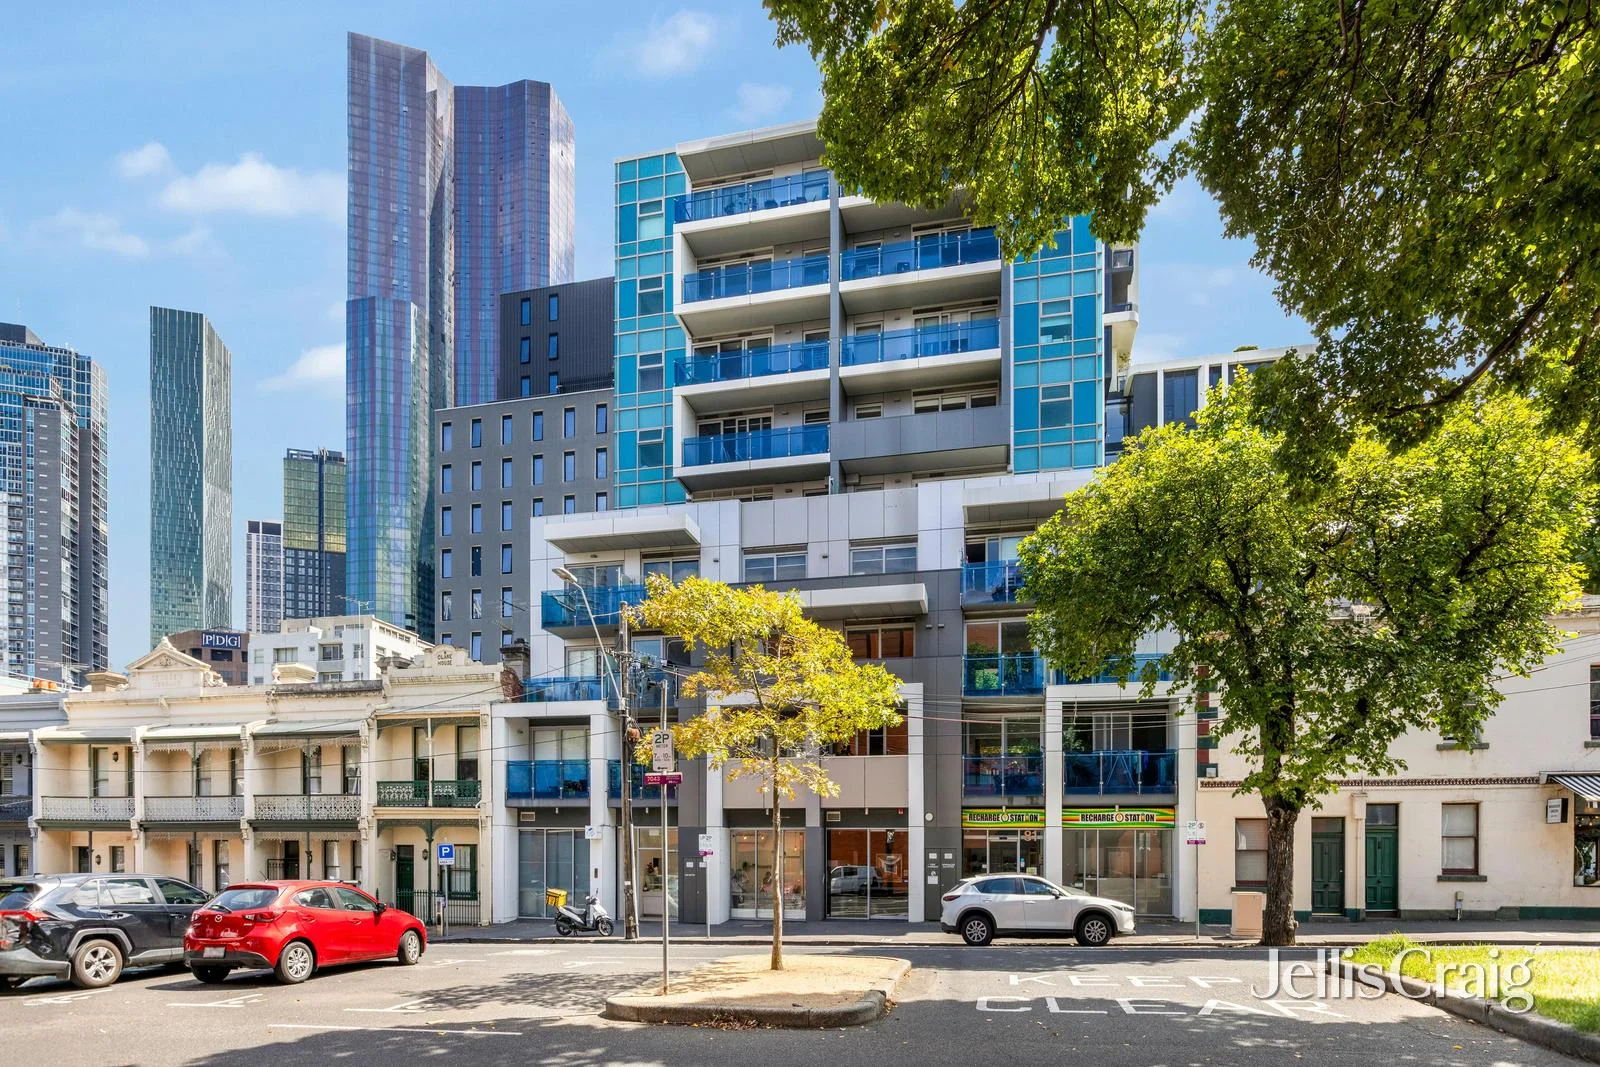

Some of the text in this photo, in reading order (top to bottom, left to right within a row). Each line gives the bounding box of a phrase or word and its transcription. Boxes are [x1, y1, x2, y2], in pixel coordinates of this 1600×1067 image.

[655, 734, 669, 743] 2P
[969, 814, 1000, 822] RECHARGE
[1081, 814, 1114, 822] RECHARGE
[442, 847, 450, 857] P
[1008, 974, 1243, 988] KEEP
[974, 995, 1350, 1018] CLEAR
